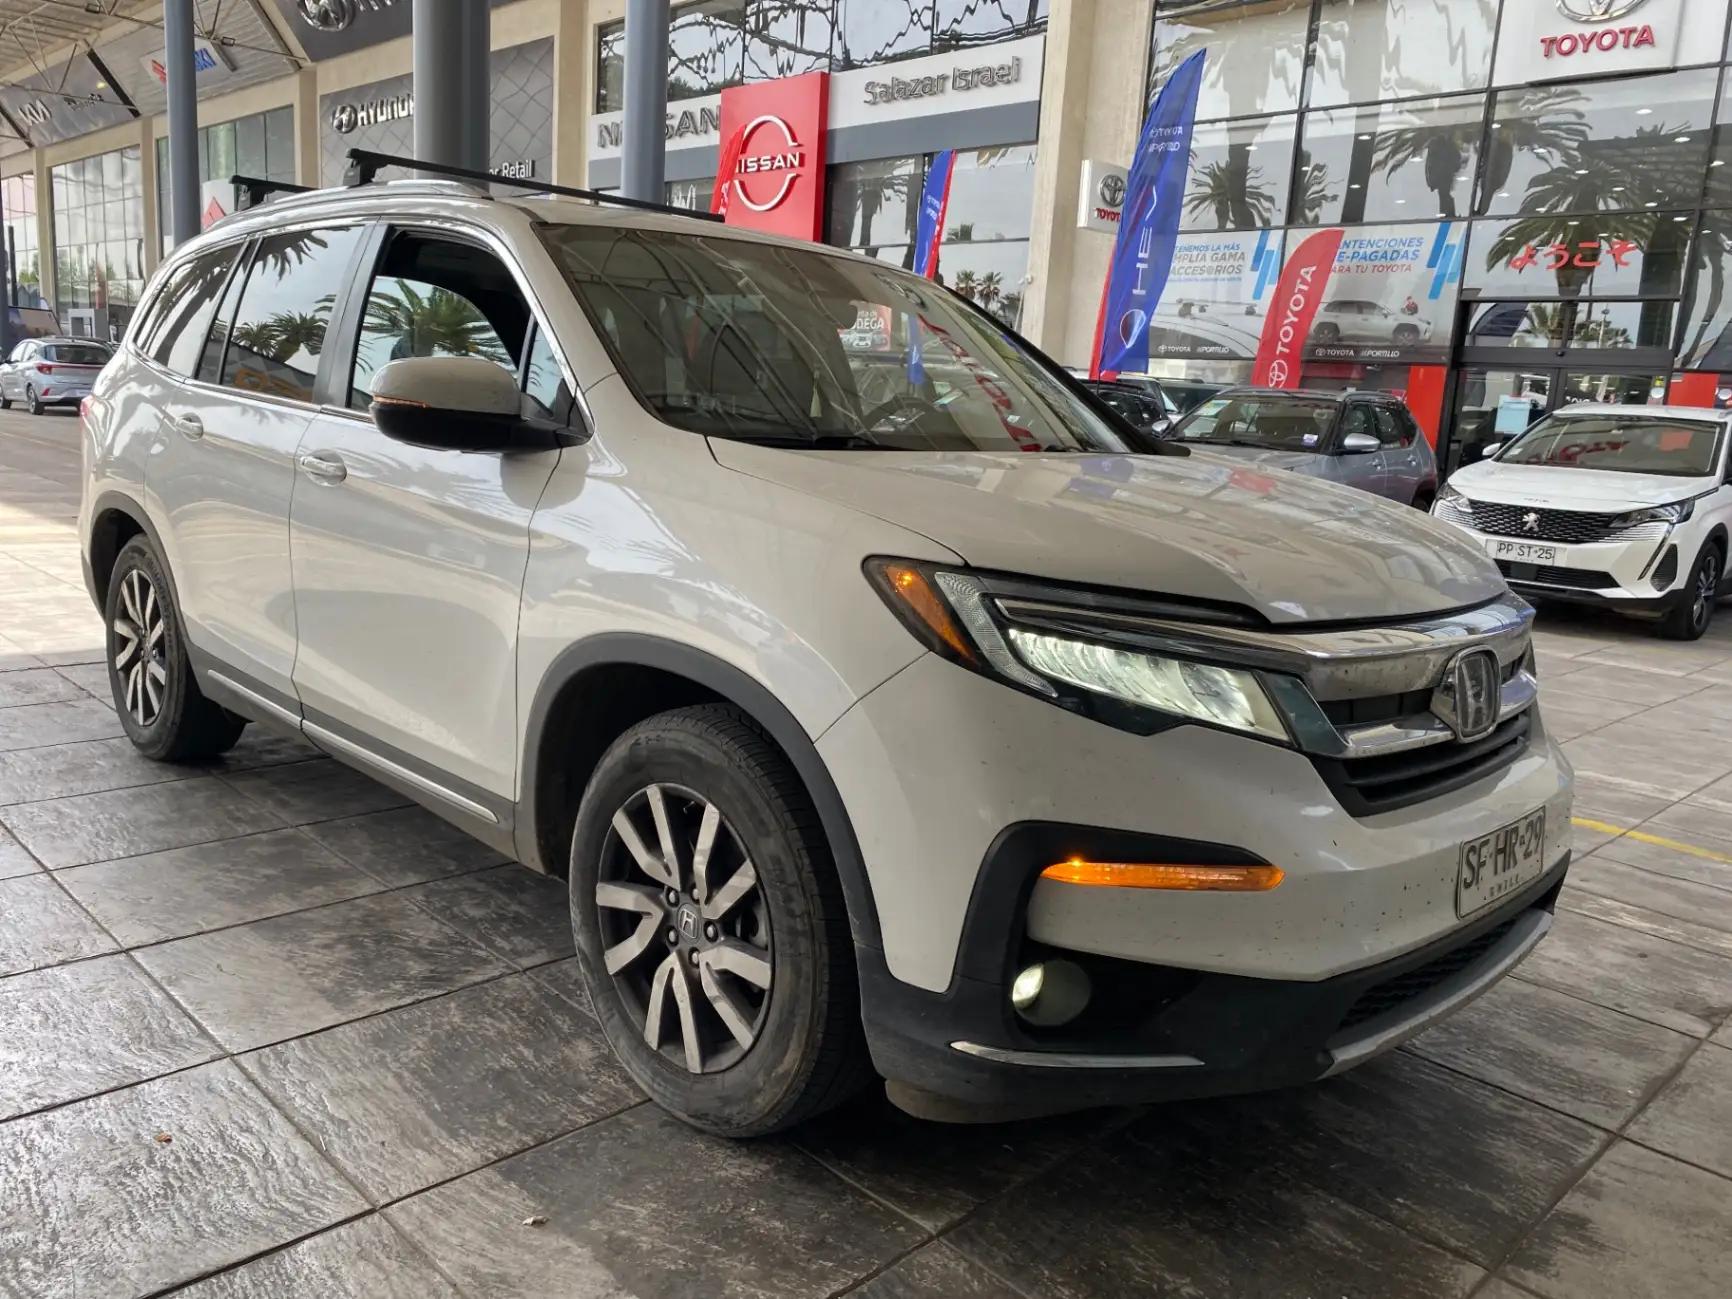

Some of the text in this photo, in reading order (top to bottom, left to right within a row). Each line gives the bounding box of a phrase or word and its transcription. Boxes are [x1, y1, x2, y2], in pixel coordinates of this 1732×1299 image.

[1540, 25, 1656, 58] TOYOTA
[864, 55, 1023, 105] Salazar Israel
[502, 159, 532, 178] Retail
[735, 151, 800, 174] ISSAN
[1093, 207, 1121, 223] TOYOT
[1131, 184, 1157, 295] HEV
[1211, 243, 1221, 252] LA
[1174, 252, 1245, 264] MPLIA GAMA
[1337, 249, 1421, 262] E-PAGADAS
[1508, 239, 1638, 272] ようこそ
[1355, 264, 1369, 273] TU
[1371, 263, 1412, 273] TOYOTA
[1276, 264, 1318, 356] TOYOTA
[1167, 345, 1191, 353] TOYOTA
[1326, 349, 1355, 357] TOYOTA
